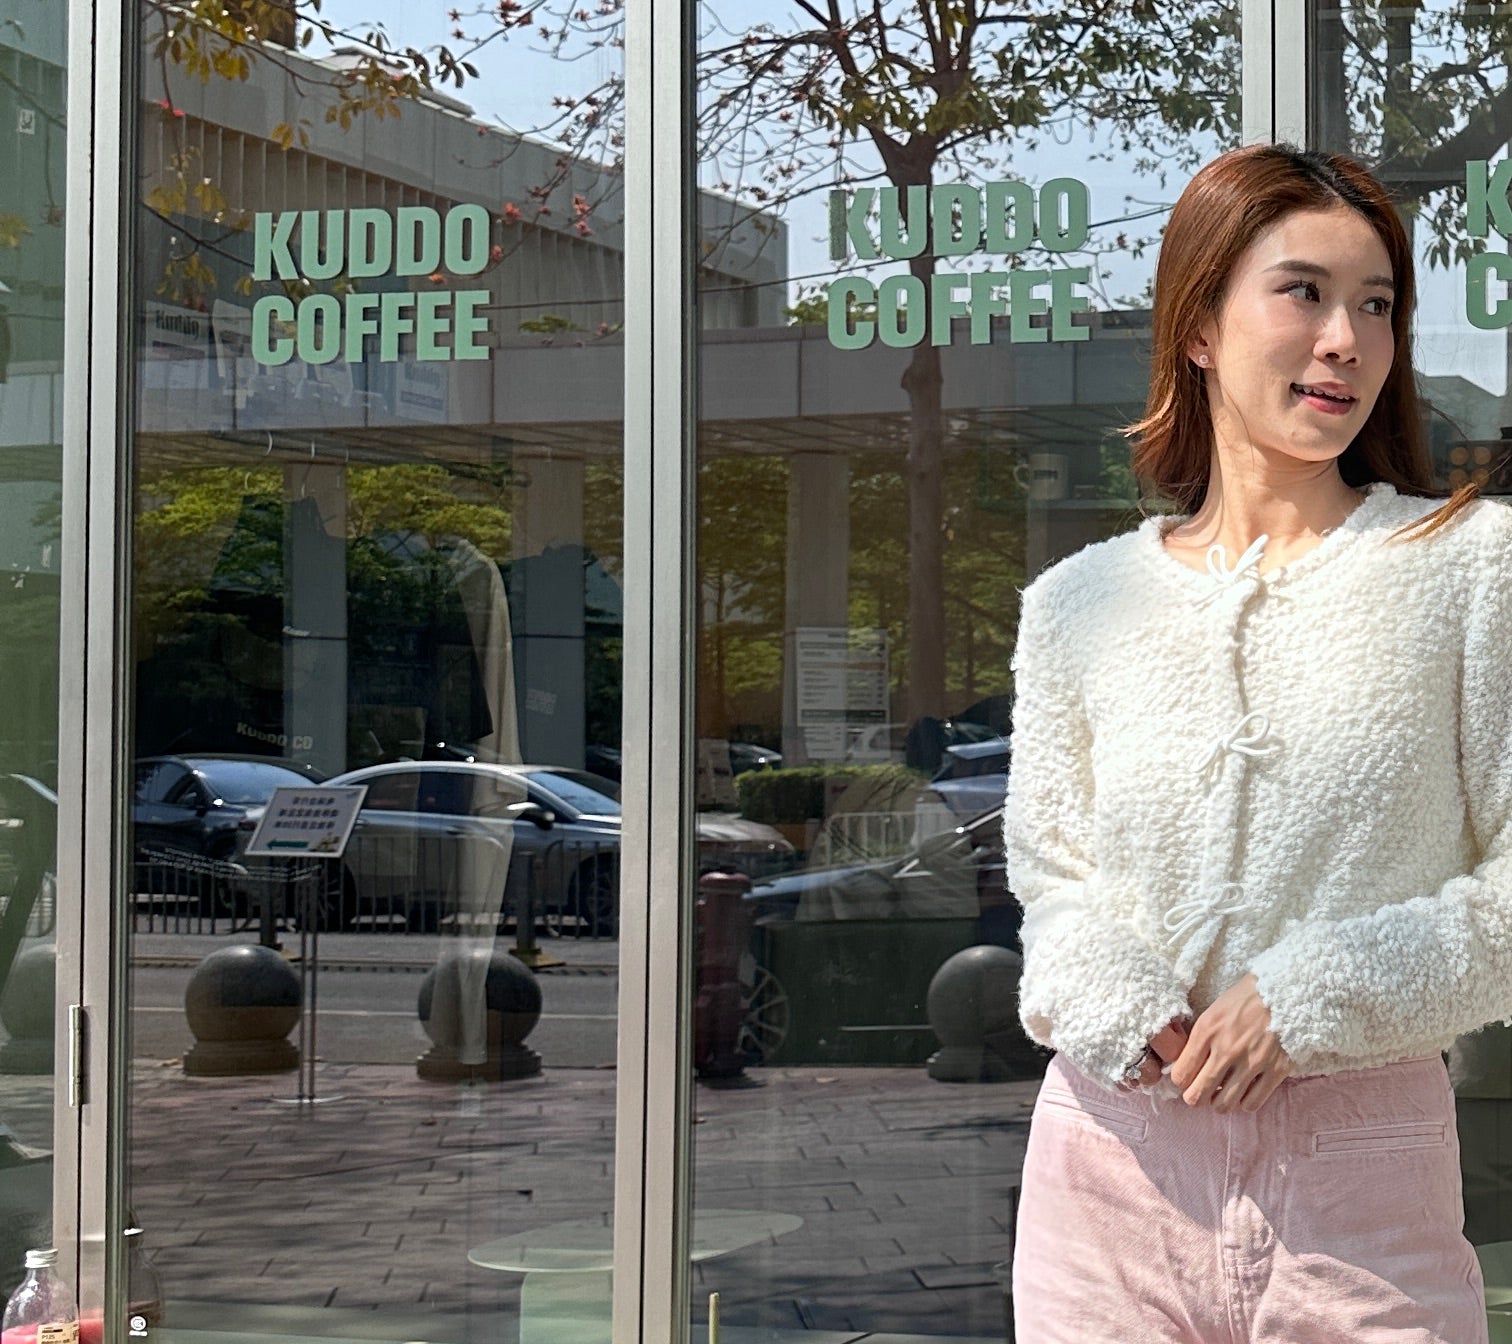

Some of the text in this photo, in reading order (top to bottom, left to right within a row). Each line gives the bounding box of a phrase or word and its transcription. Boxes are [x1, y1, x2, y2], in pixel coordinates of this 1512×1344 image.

[254, 203, 490, 282] KUDDO
[829, 177, 1089, 260] KUDDO
[252, 289, 490, 366] COFFEE
[828, 267, 1091, 350] COFFEE
